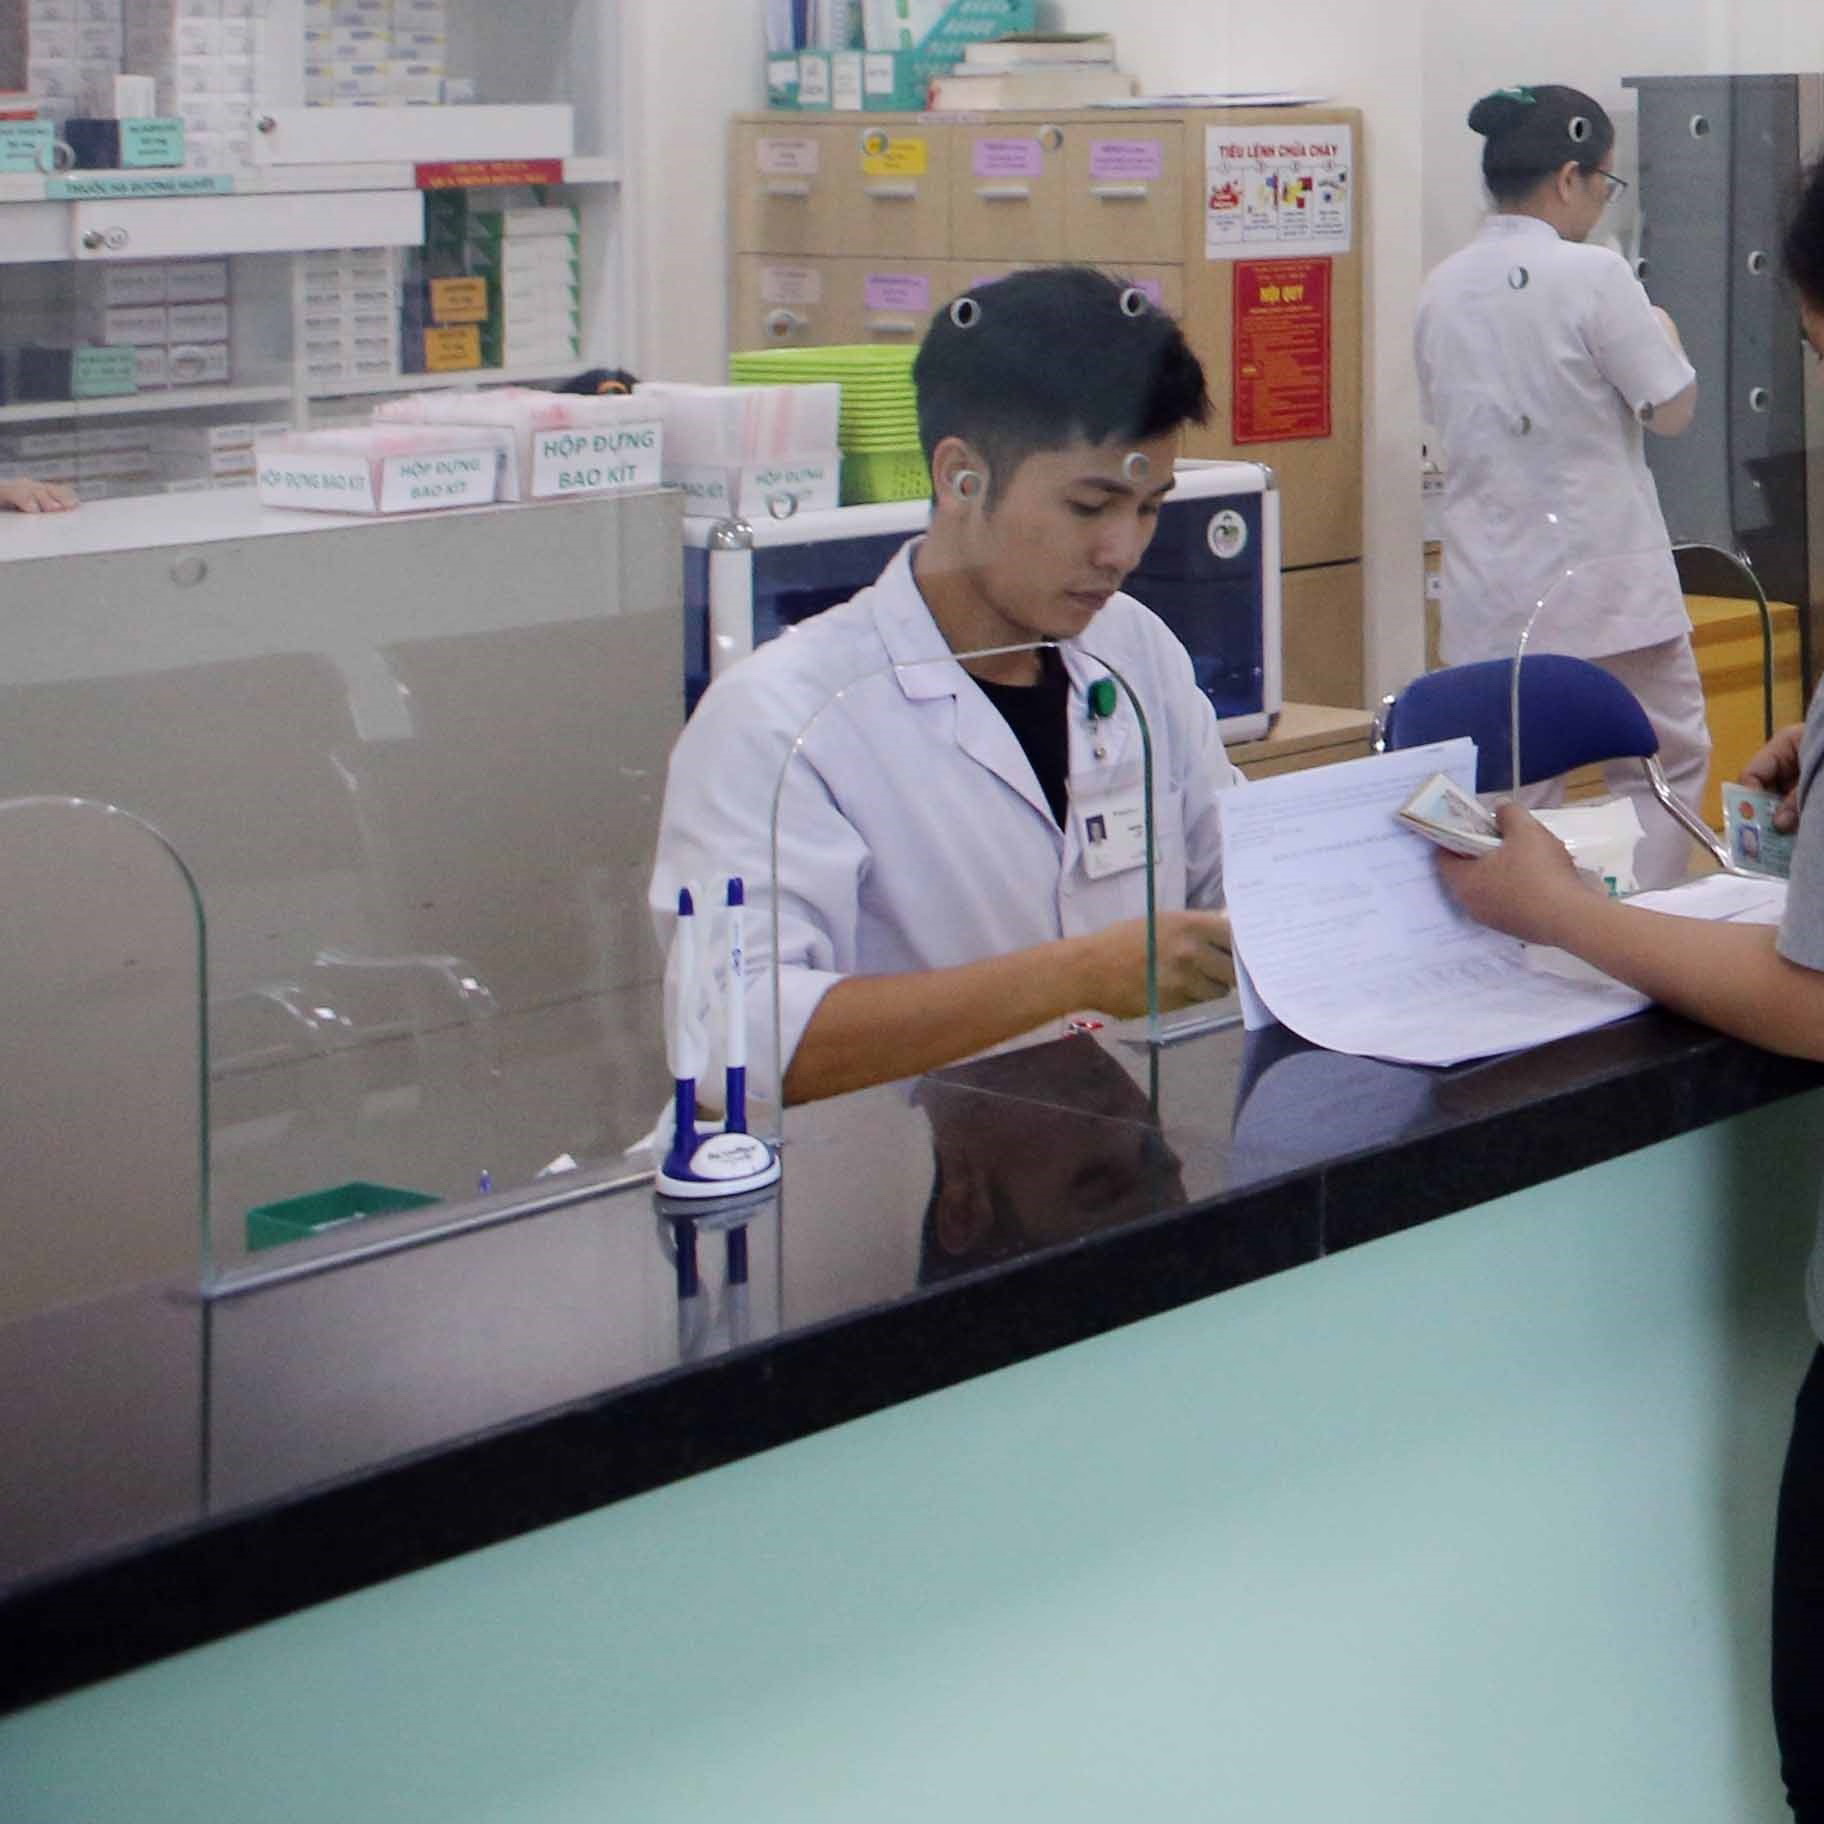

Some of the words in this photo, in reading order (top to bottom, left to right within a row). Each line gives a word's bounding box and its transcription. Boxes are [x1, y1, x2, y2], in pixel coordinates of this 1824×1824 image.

[543, 435, 587, 457] HỘP
[592, 429, 655, 454] ĐỰNG
[559, 468, 602, 489] BAO
